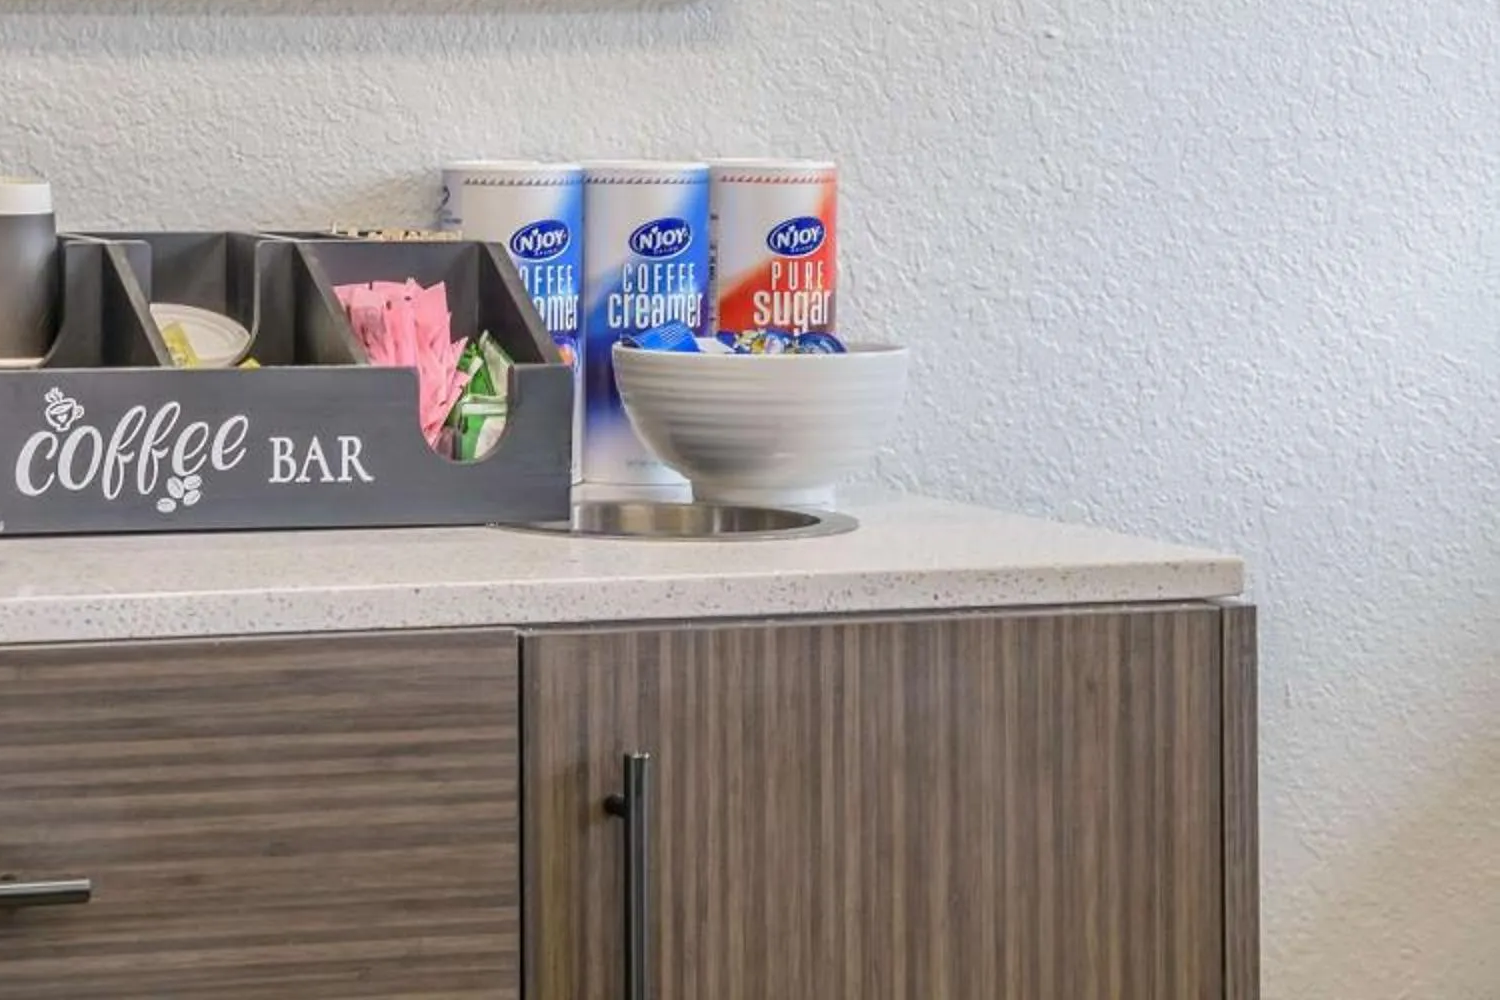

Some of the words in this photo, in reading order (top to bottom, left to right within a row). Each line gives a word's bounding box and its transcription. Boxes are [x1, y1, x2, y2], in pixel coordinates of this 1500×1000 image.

[519, 264, 573, 295] OFFEE
[623, 263, 695, 293] COFFEE
[771, 260, 824, 291] PURE
[608, 292, 703, 330] creamer
[753, 289, 831, 336] sugar
[268, 436, 374, 484] BAR
